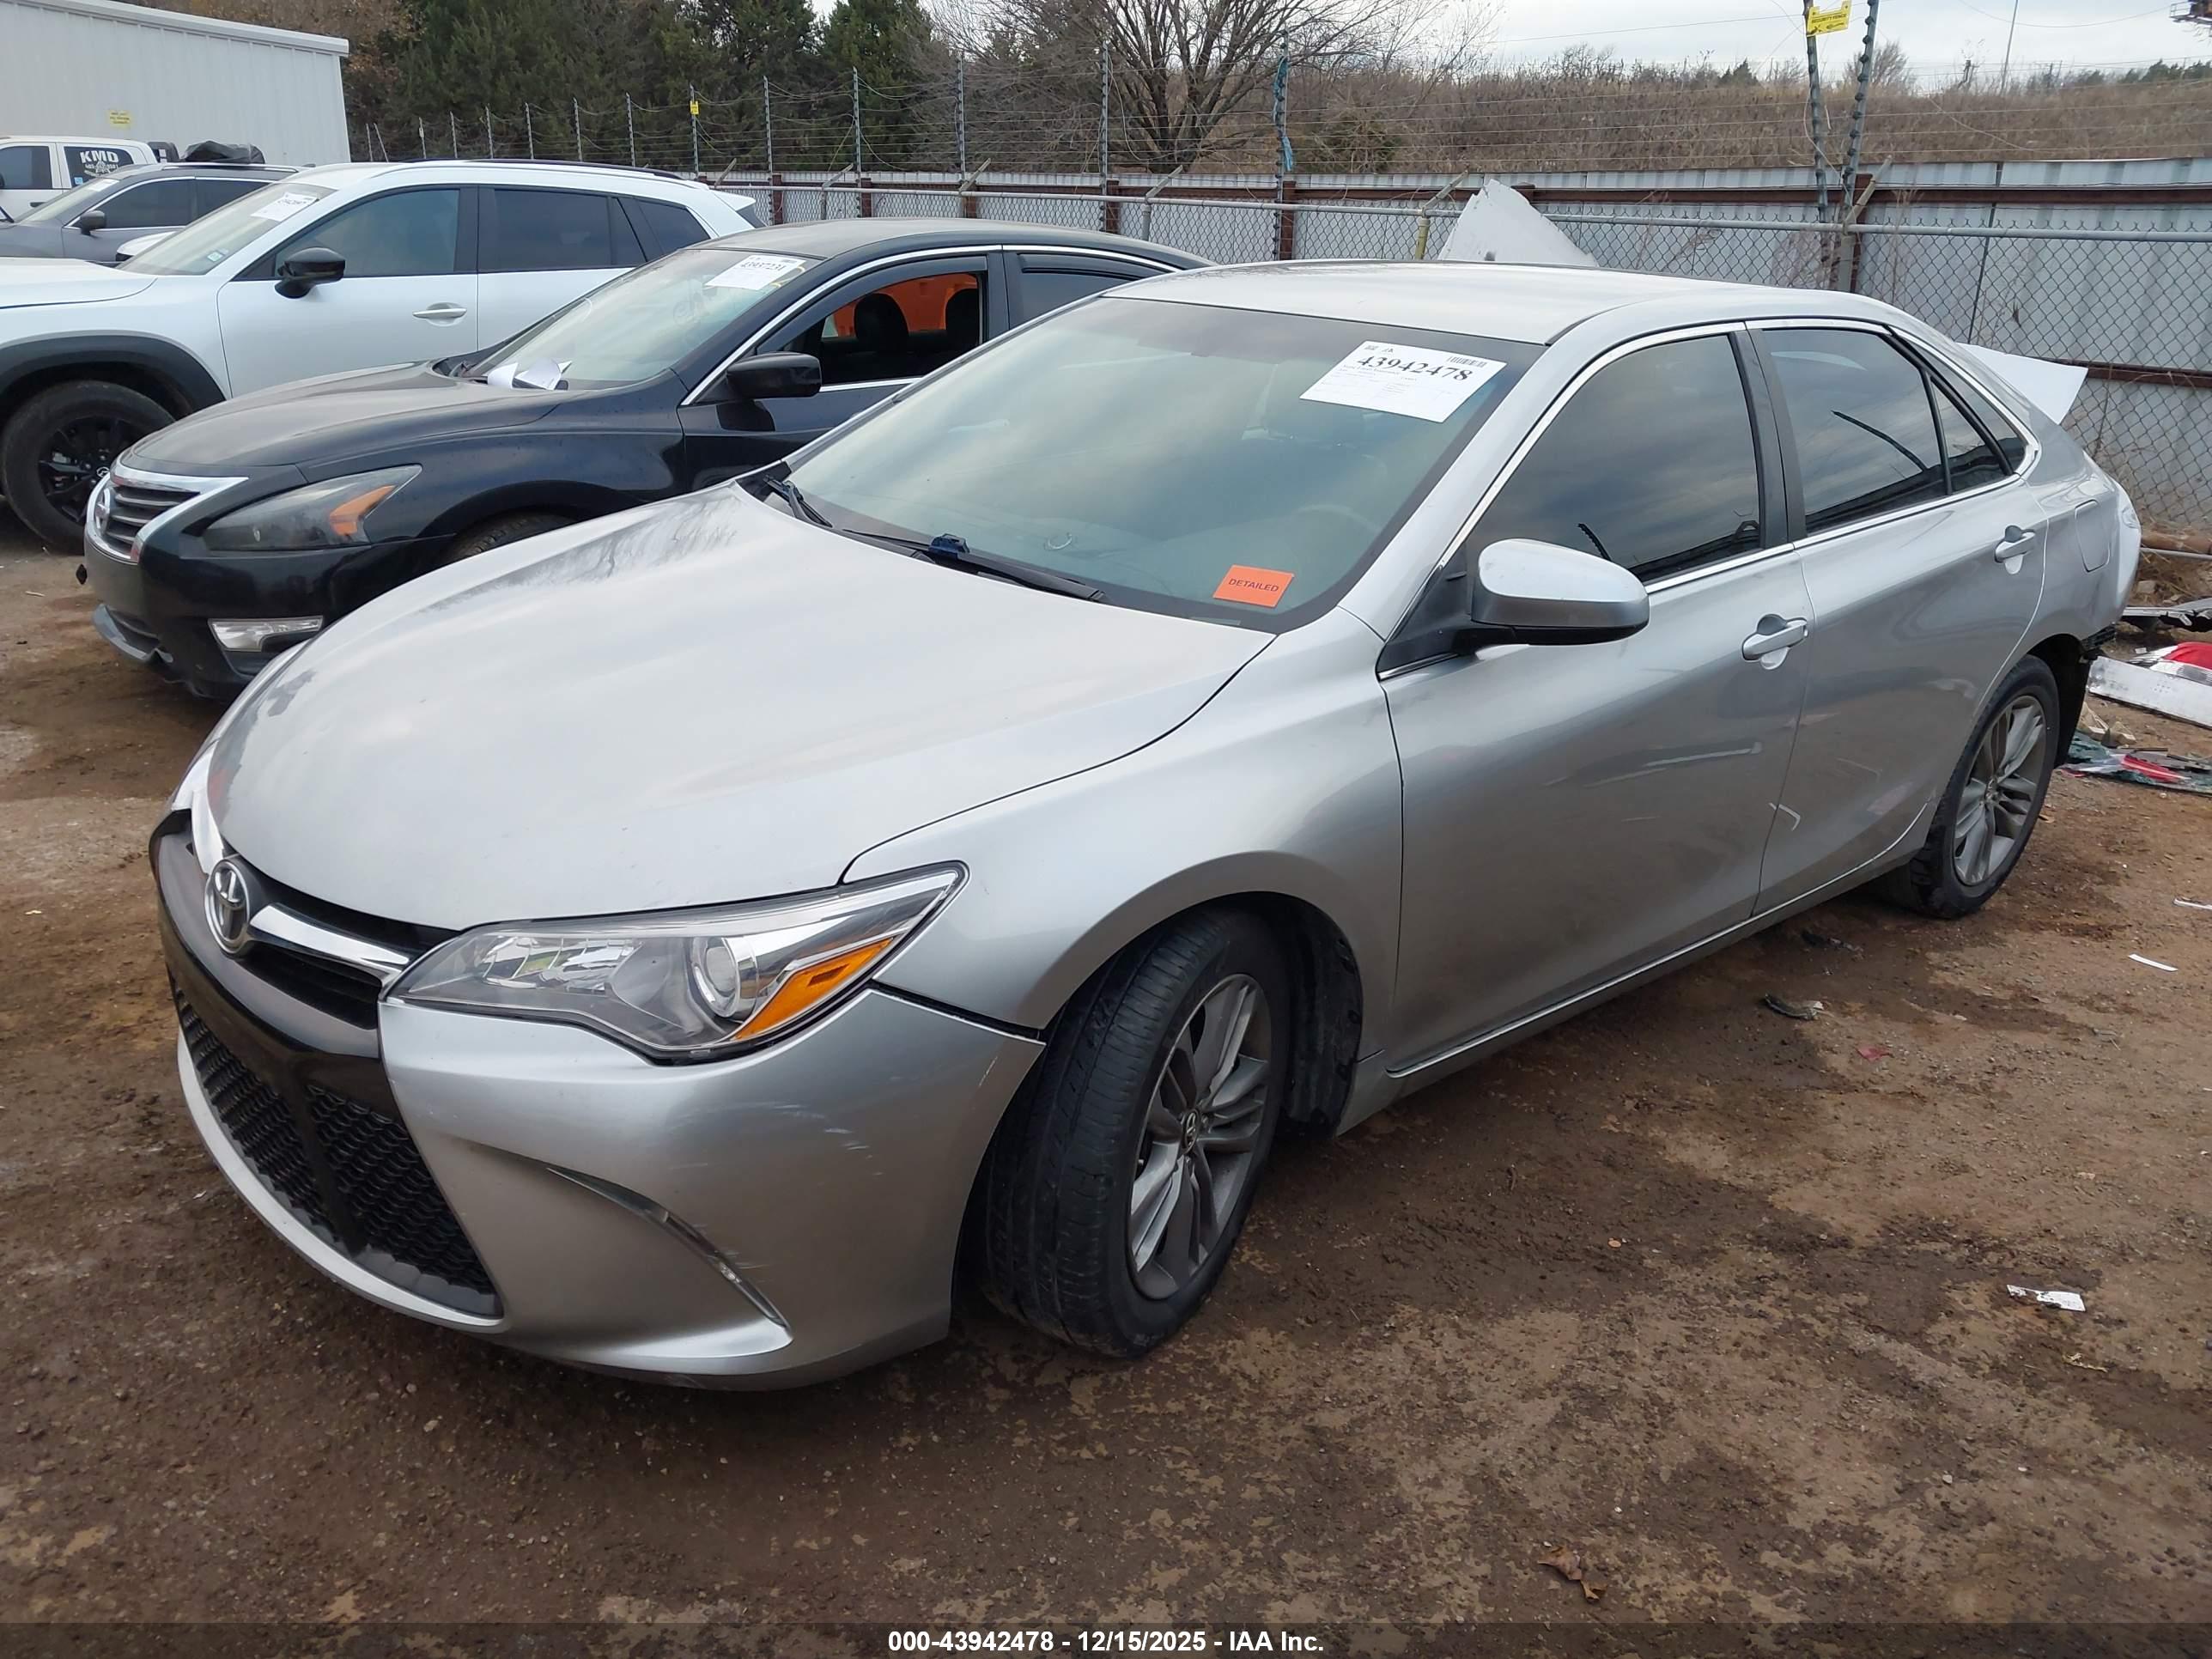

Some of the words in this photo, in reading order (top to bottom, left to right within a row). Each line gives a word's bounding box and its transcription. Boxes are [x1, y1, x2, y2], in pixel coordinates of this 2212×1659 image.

[80, 150, 119, 163] KMD
[1358, 356, 1474, 381] 43942478
[1228, 578, 1279, 592] DETAILED
